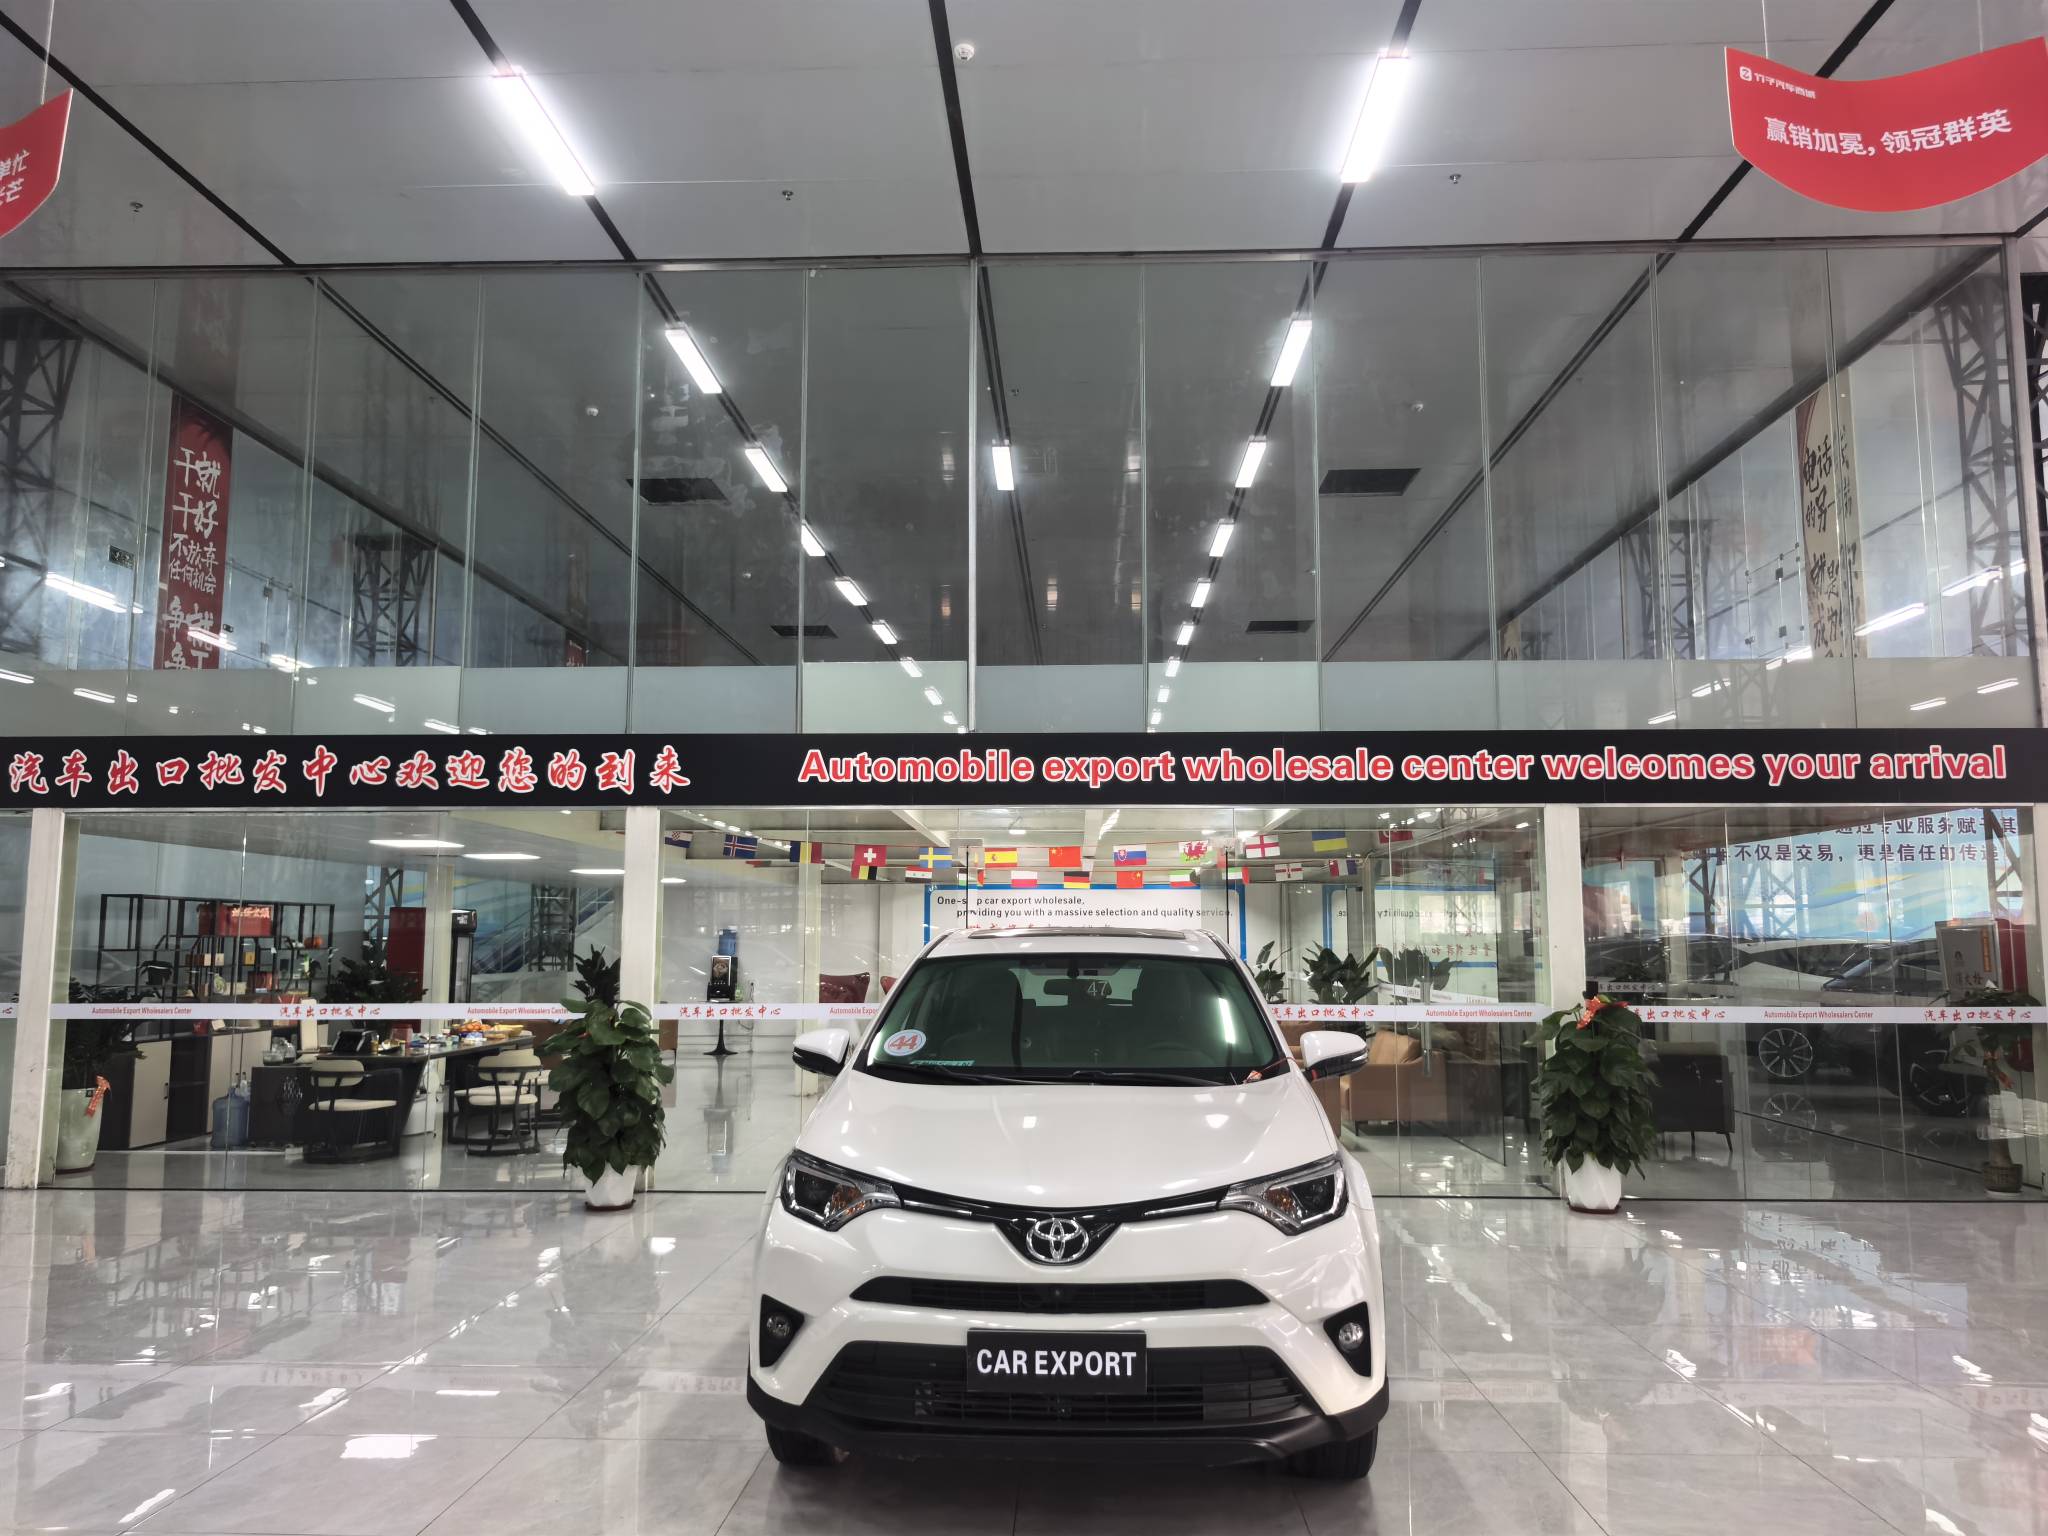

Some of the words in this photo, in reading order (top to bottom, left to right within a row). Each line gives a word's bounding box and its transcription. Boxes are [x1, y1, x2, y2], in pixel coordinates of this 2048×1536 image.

[9, 745, 690, 797] 汽车出口批发中心欢迎您的到来
[798, 749, 1034, 782] Automobile
[1042, 751, 1175, 788] export
[1182, 747, 1393, 781] wholesale
[1401, 749, 1534, 781] center
[1541, 746, 1755, 780] welcomes
[1762, 753, 1861, 787] your
[1870, 745, 2006, 779] arrival
[937, 896, 982, 906] One-sp
[1001, 896, 1031, 906] export
[1034, 896, 1085, 905] wholesale,
[957, 908, 1002, 918] prviding
[1005, 910, 1021, 918] you
[1024, 908, 1045, 916] with
[1055, 908, 1093, 916] massive
[1096, 908, 1138, 916] selection
[1141, 908, 1158, 916] and
[1160, 908, 1194, 918] quality
[1088, 981, 1107, 996] 47
[92, 1007, 122, 1015] Automobile
[123, 1007, 141, 1016] Export
[174, 1007, 192, 1015] Center
[280, 1006, 380, 1018] 汽车出口批发中心
[467, 1007, 498, 1015] Automobile
[500, 1007, 517, 1016] Export
[679, 1006, 782, 1018] 汽车出口批发中心
[862, 1006, 879, 1016] Expo
[1426, 1009, 1458, 1017] Automobile
[1459, 1009, 1478, 1018] Export
[1514, 1009, 1532, 1017] Center
[1764, 1010, 1797, 1018] Automobile
[1798, 1010, 1817, 1019] Export
[1854, 1010, 1873, 1018] Center
[1925, 1008, 2032, 1021] 汽车出口批发中心
[888, 1033, 919, 1050] 44
[977, 1349, 1027, 1375] CAR
[1035, 1351, 1136, 1376] EXPORT
